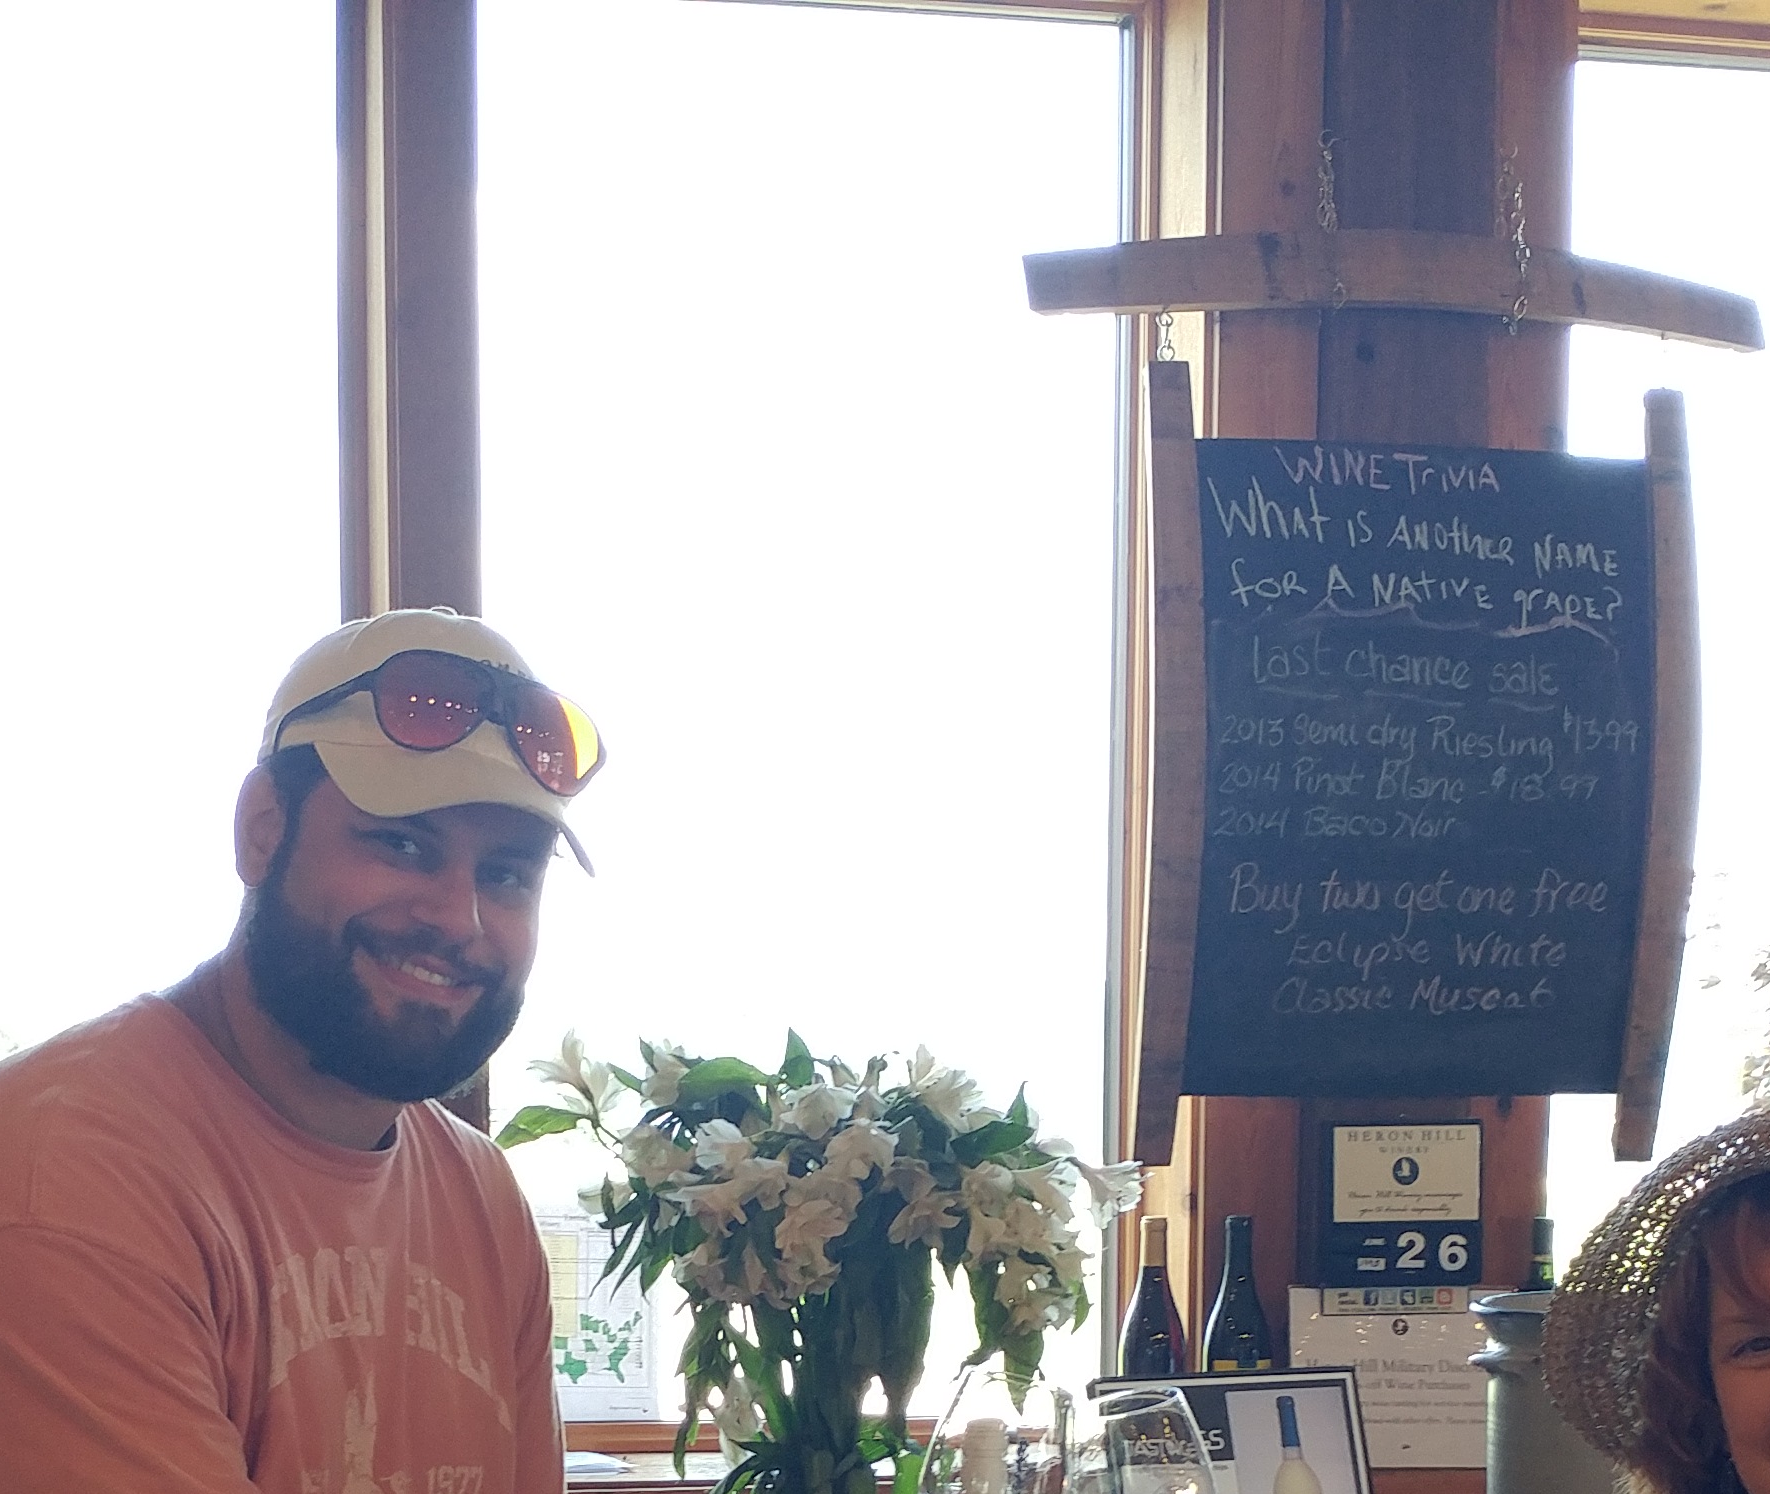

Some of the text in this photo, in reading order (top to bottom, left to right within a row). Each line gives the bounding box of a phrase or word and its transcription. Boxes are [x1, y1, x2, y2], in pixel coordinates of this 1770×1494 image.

[1274, 445, 1391, 491] WINE
[1533, 532, 1620, 580] NAME
[1328, 563, 1356, 600] A
[1217, 714, 1285, 748] 2013
[1367, 711, 1419, 764] dry
[1425, 713, 1556, 776] Riesling
[1217, 760, 1282, 795] 2014
[1373, 756, 1467, 805] Blanc
[1212, 806, 1291, 841] 2014
[1228, 861, 1305, 935] Buy
[1393, 868, 1455, 942] get
[1455, 886, 1516, 917] one
[1527, 866, 1610, 919] free
[1347, 1128, 1467, 1143] HERON HILL
[1395, 1231, 1469, 1272] 26
